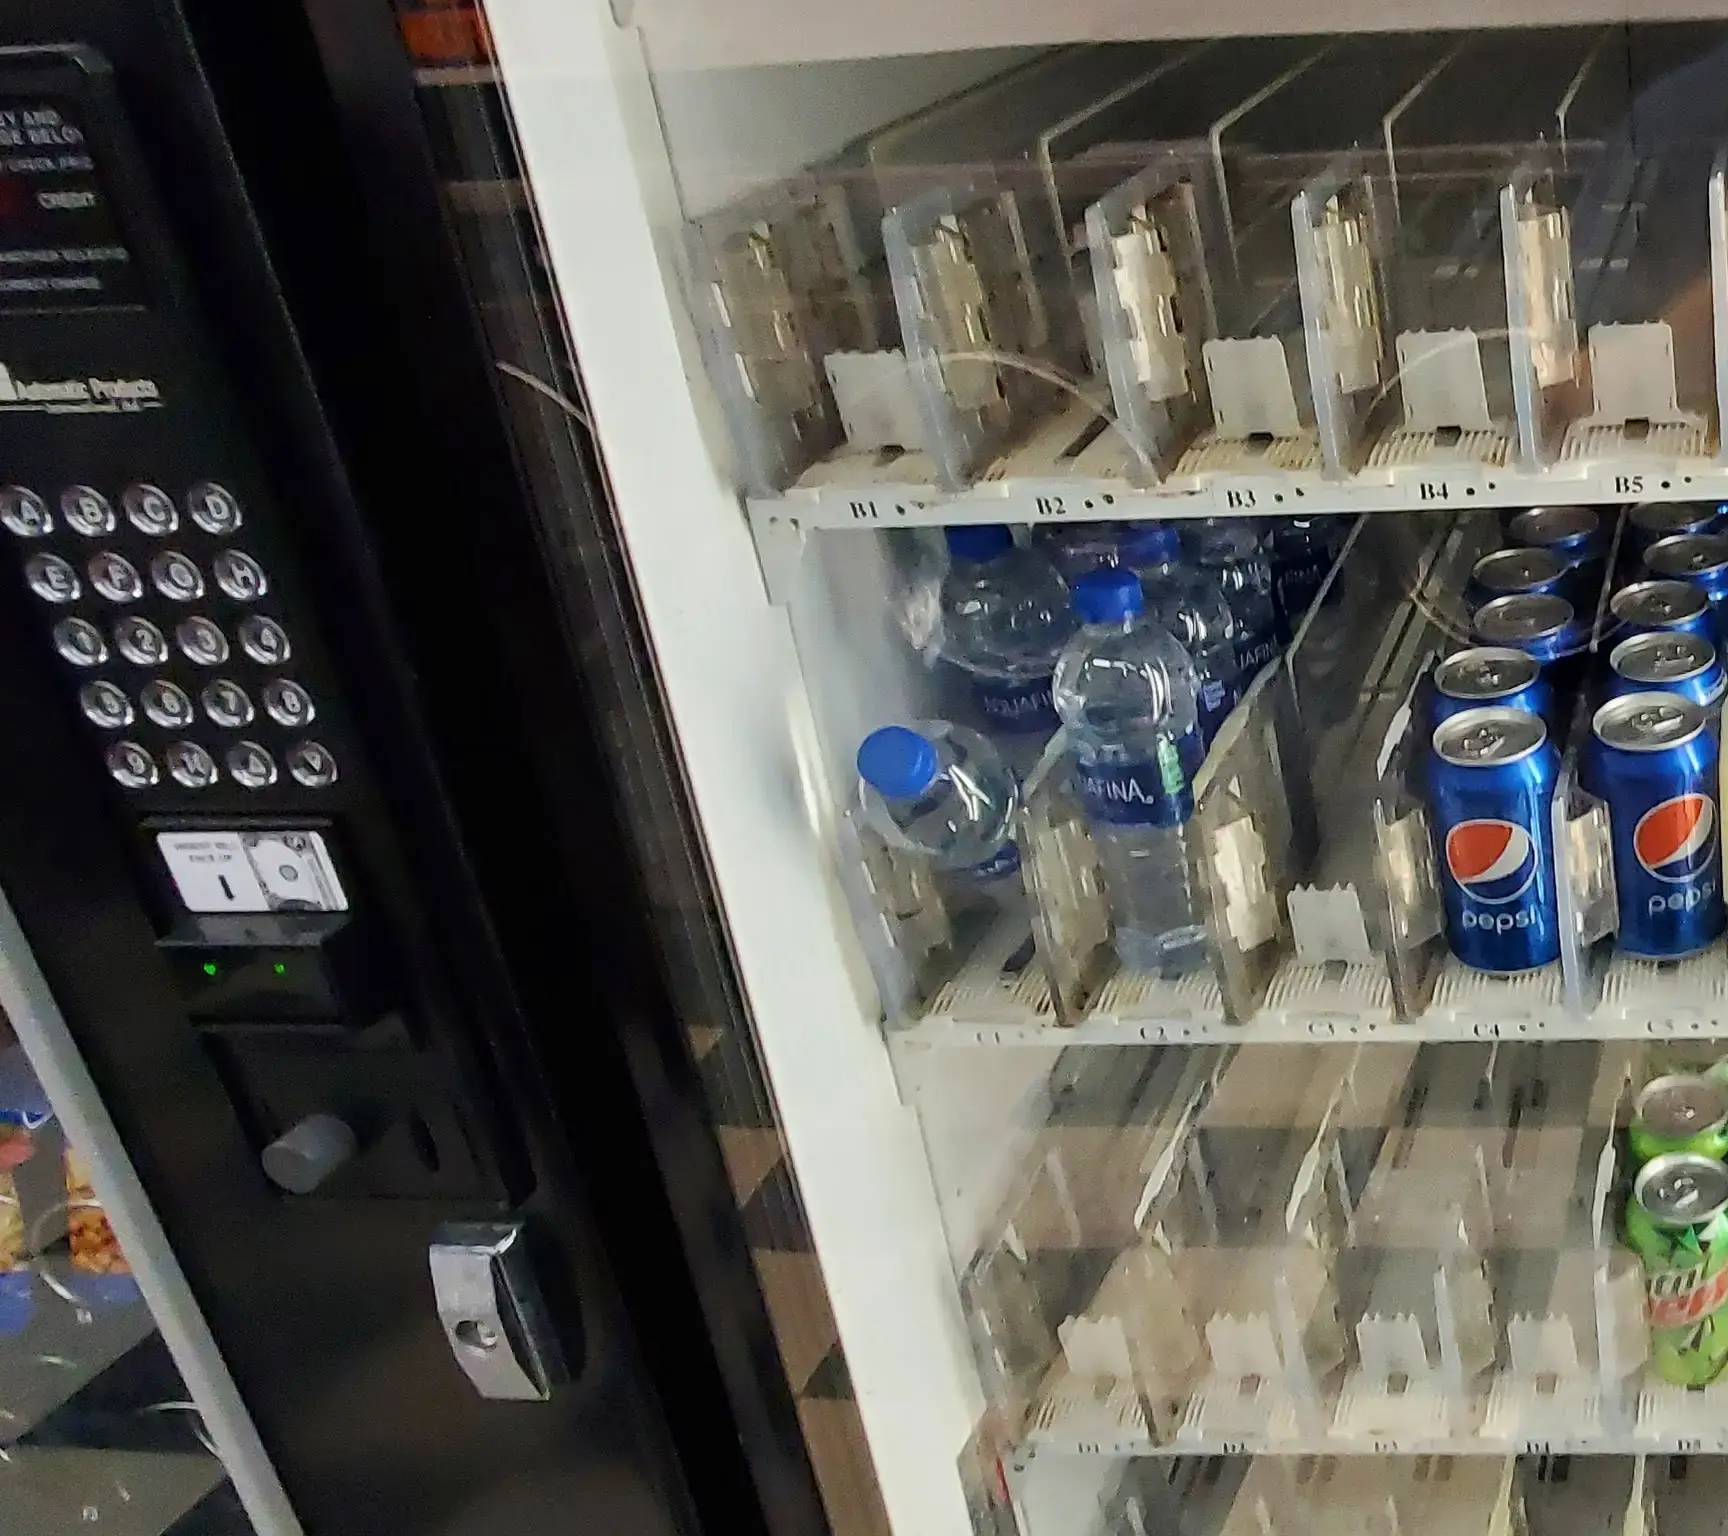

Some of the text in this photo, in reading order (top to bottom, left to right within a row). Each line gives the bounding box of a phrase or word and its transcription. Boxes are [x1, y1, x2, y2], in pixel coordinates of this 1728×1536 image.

[143, 496, 166, 521] C
[205, 494, 228, 519] D
[1036, 495, 1067, 516] B2
[1226, 489, 1257, 509] B3
[1419, 482, 1449, 501] B4
[1614, 474, 1645, 495] B5
[1461, 907, 1540, 937] pepsi
